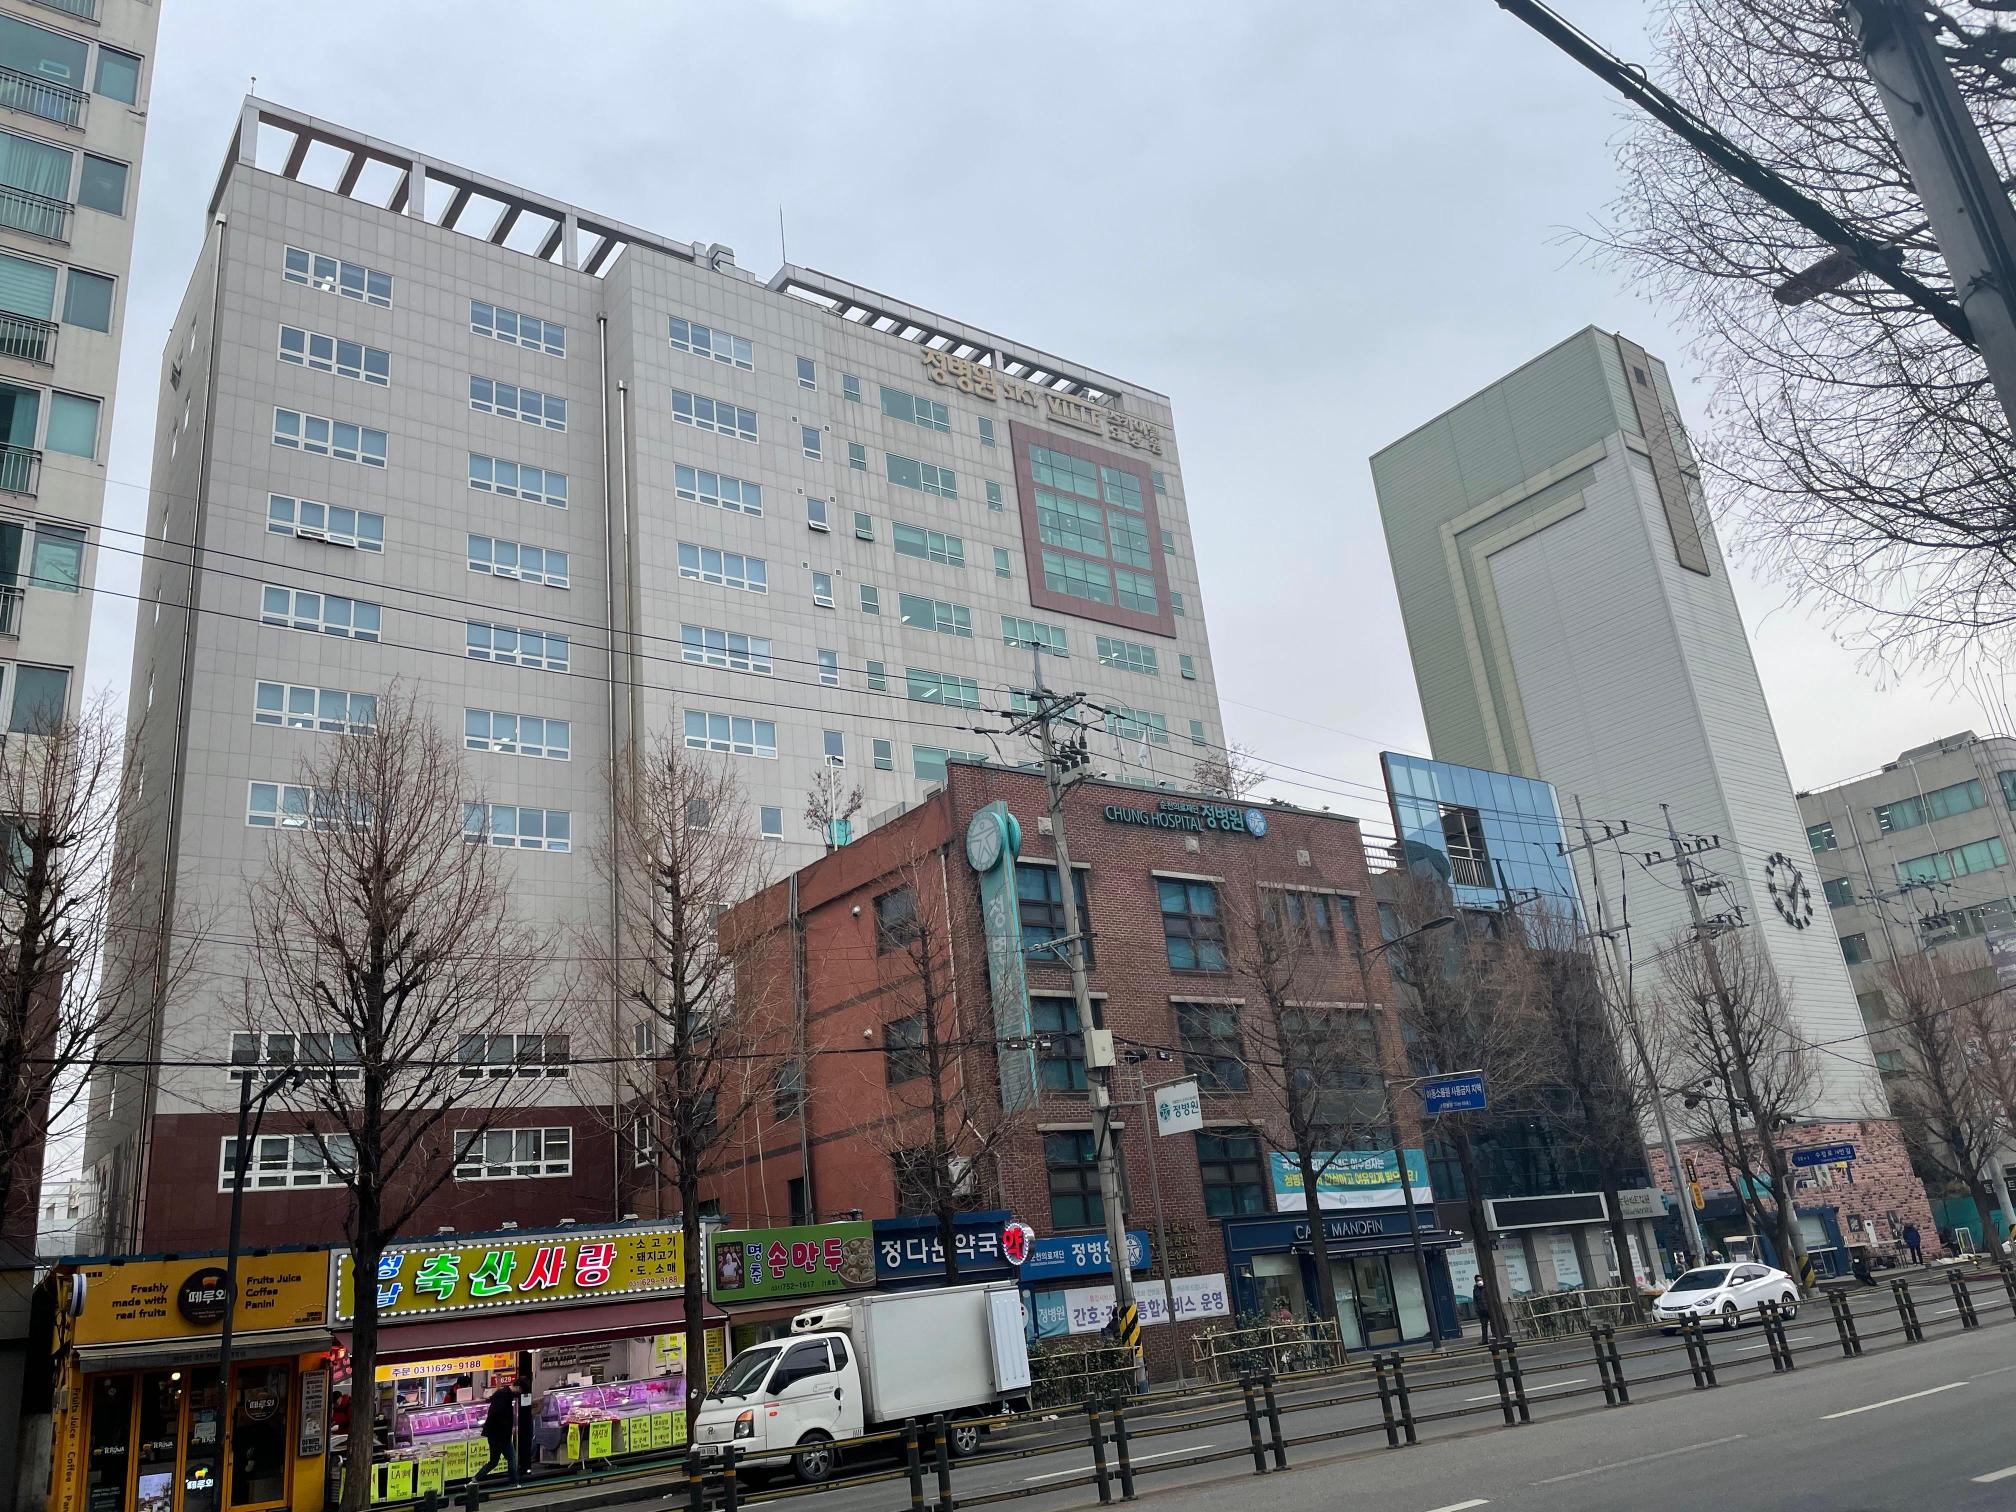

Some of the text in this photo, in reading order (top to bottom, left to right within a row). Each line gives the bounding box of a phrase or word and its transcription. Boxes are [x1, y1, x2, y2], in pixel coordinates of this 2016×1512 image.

[921, 347, 997, 402] 정병원
[1003, 380, 1041, 409] SKY
[1047, 396, 1101, 427] VILLE
[1105, 805, 1204, 832] CHUNG HOSPITAL
[1201, 804, 1245, 831] 정병원
[1172, 1100, 1200, 1118] 정병원
[1386, 1169, 1418, 1182] 받으요!
[1002, 1226, 1025, 1259] 약
[636, 1249, 676, 1262] 돼지고기
[768, 1238, 844, 1279] 손만두
[131, 1283, 169, 1294] Freshly
[246, 1274, 302, 1285] Fruits Juice
[112, 1294, 168, 1308] made with
[245, 1288, 279, 1297] Coffee
[1200, 1291, 1224, 1311] 운영
[245, 1299, 275, 1309] Panini
[116, 1308, 167, 1320] real fruits
[1039, 1305, 1065, 1323] 정병원
[392, 1360, 481, 1376] 주문 031)629-9188
[72, 1388, 81, 1413] Fruits
[70, 1415, 79, 1438] Juice
[65, 1451, 76, 1483] Coffee
